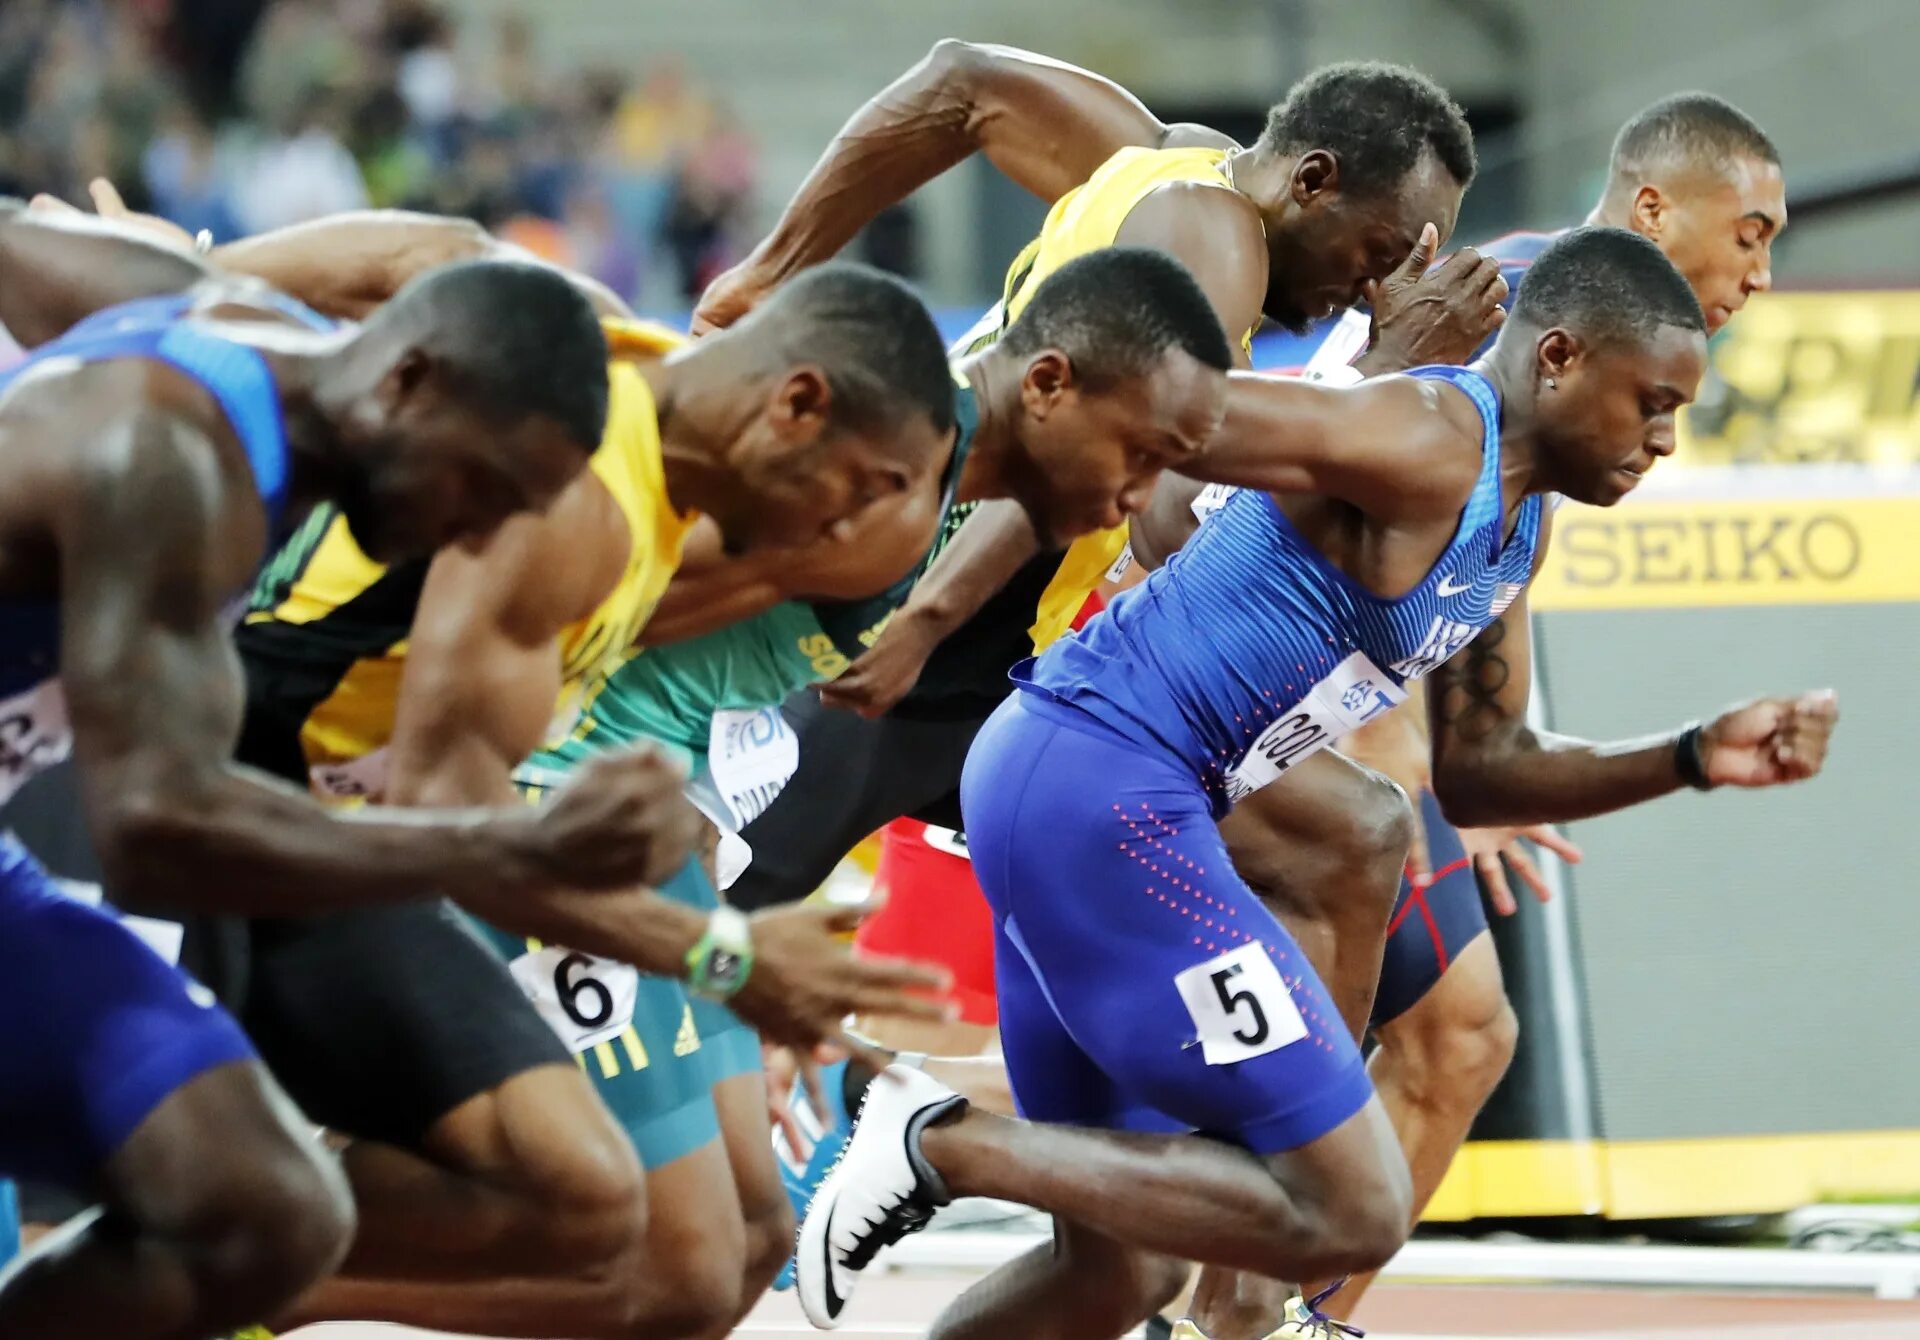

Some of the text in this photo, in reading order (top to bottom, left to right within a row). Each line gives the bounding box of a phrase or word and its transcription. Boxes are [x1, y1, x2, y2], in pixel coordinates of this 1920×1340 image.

[1560, 513, 1863, 587] SEIKO
[554, 951, 613, 1027] 6
[1210, 963, 1269, 1046] 5
